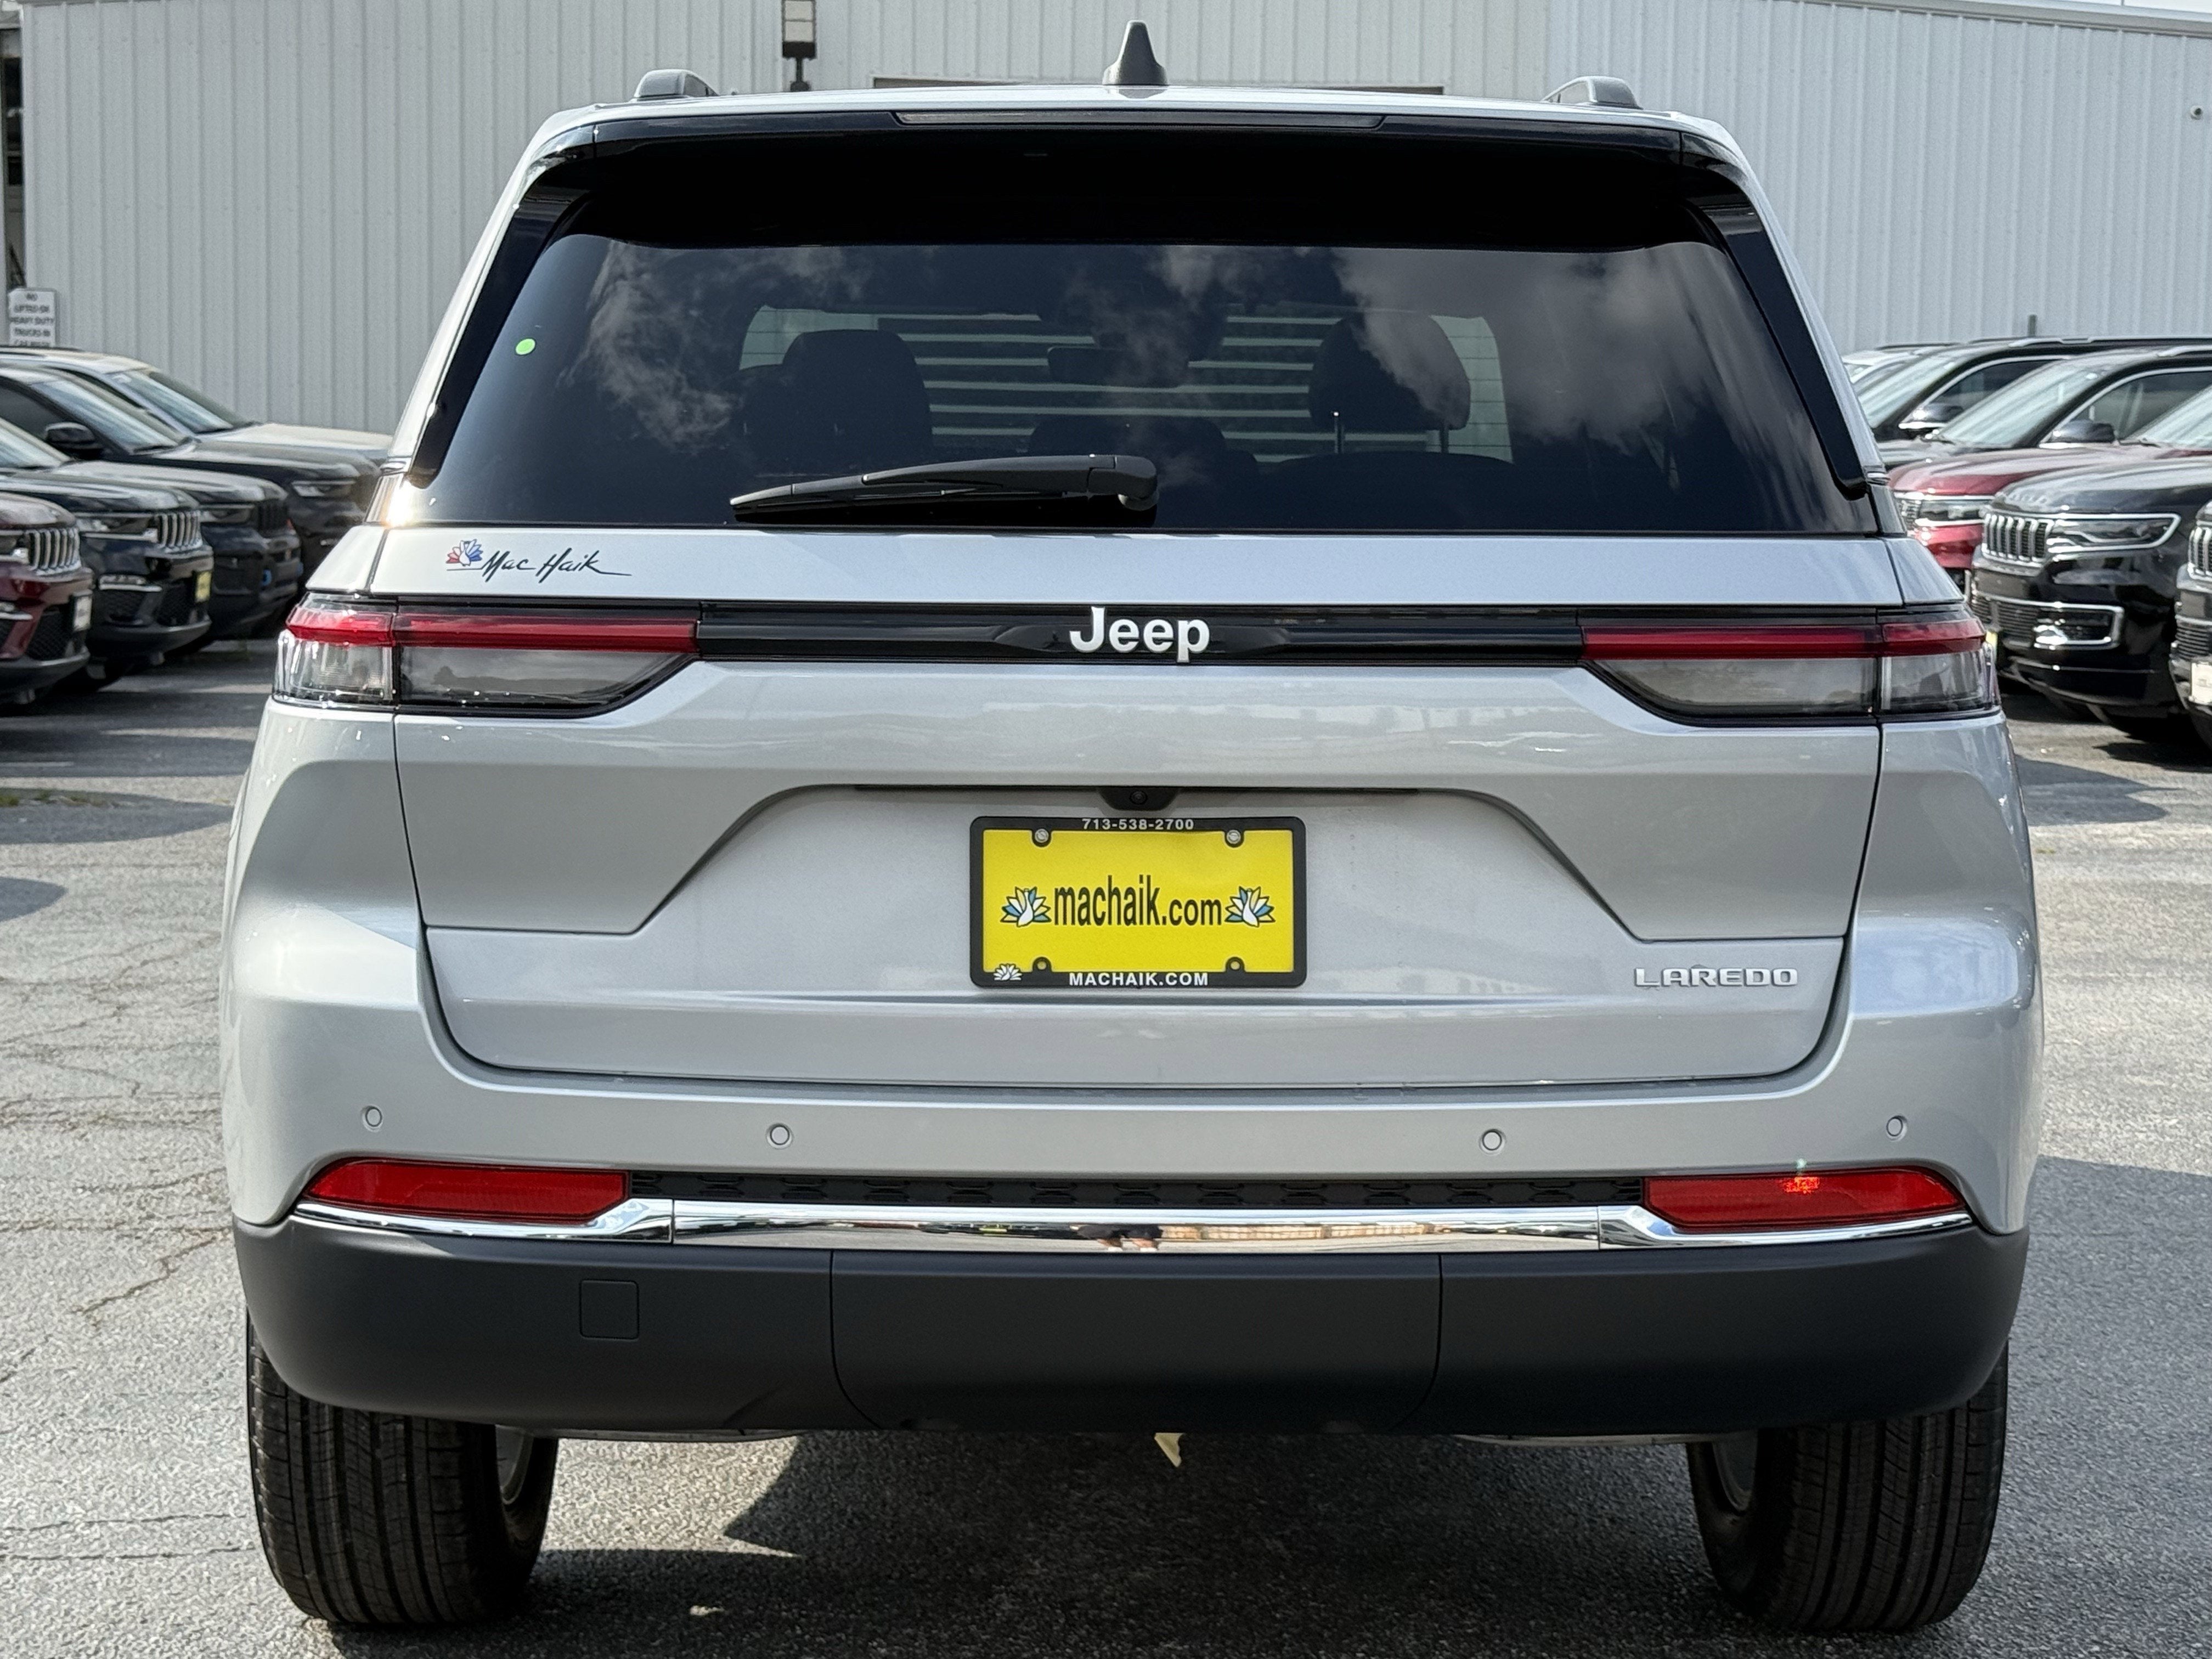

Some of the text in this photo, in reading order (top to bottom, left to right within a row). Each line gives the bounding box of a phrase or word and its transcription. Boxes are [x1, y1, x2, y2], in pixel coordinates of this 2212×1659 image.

[481, 548, 631, 583] Mac Haik
[1070, 606, 1210, 663] Jeep
[1081, 818, 1194, 830] 713-538-2700
[1054, 874, 1222, 926] machaik.com
[1069, 972, 1208, 986] MACHAIK.COM
[1634, 968, 1798, 987] LAREDO
